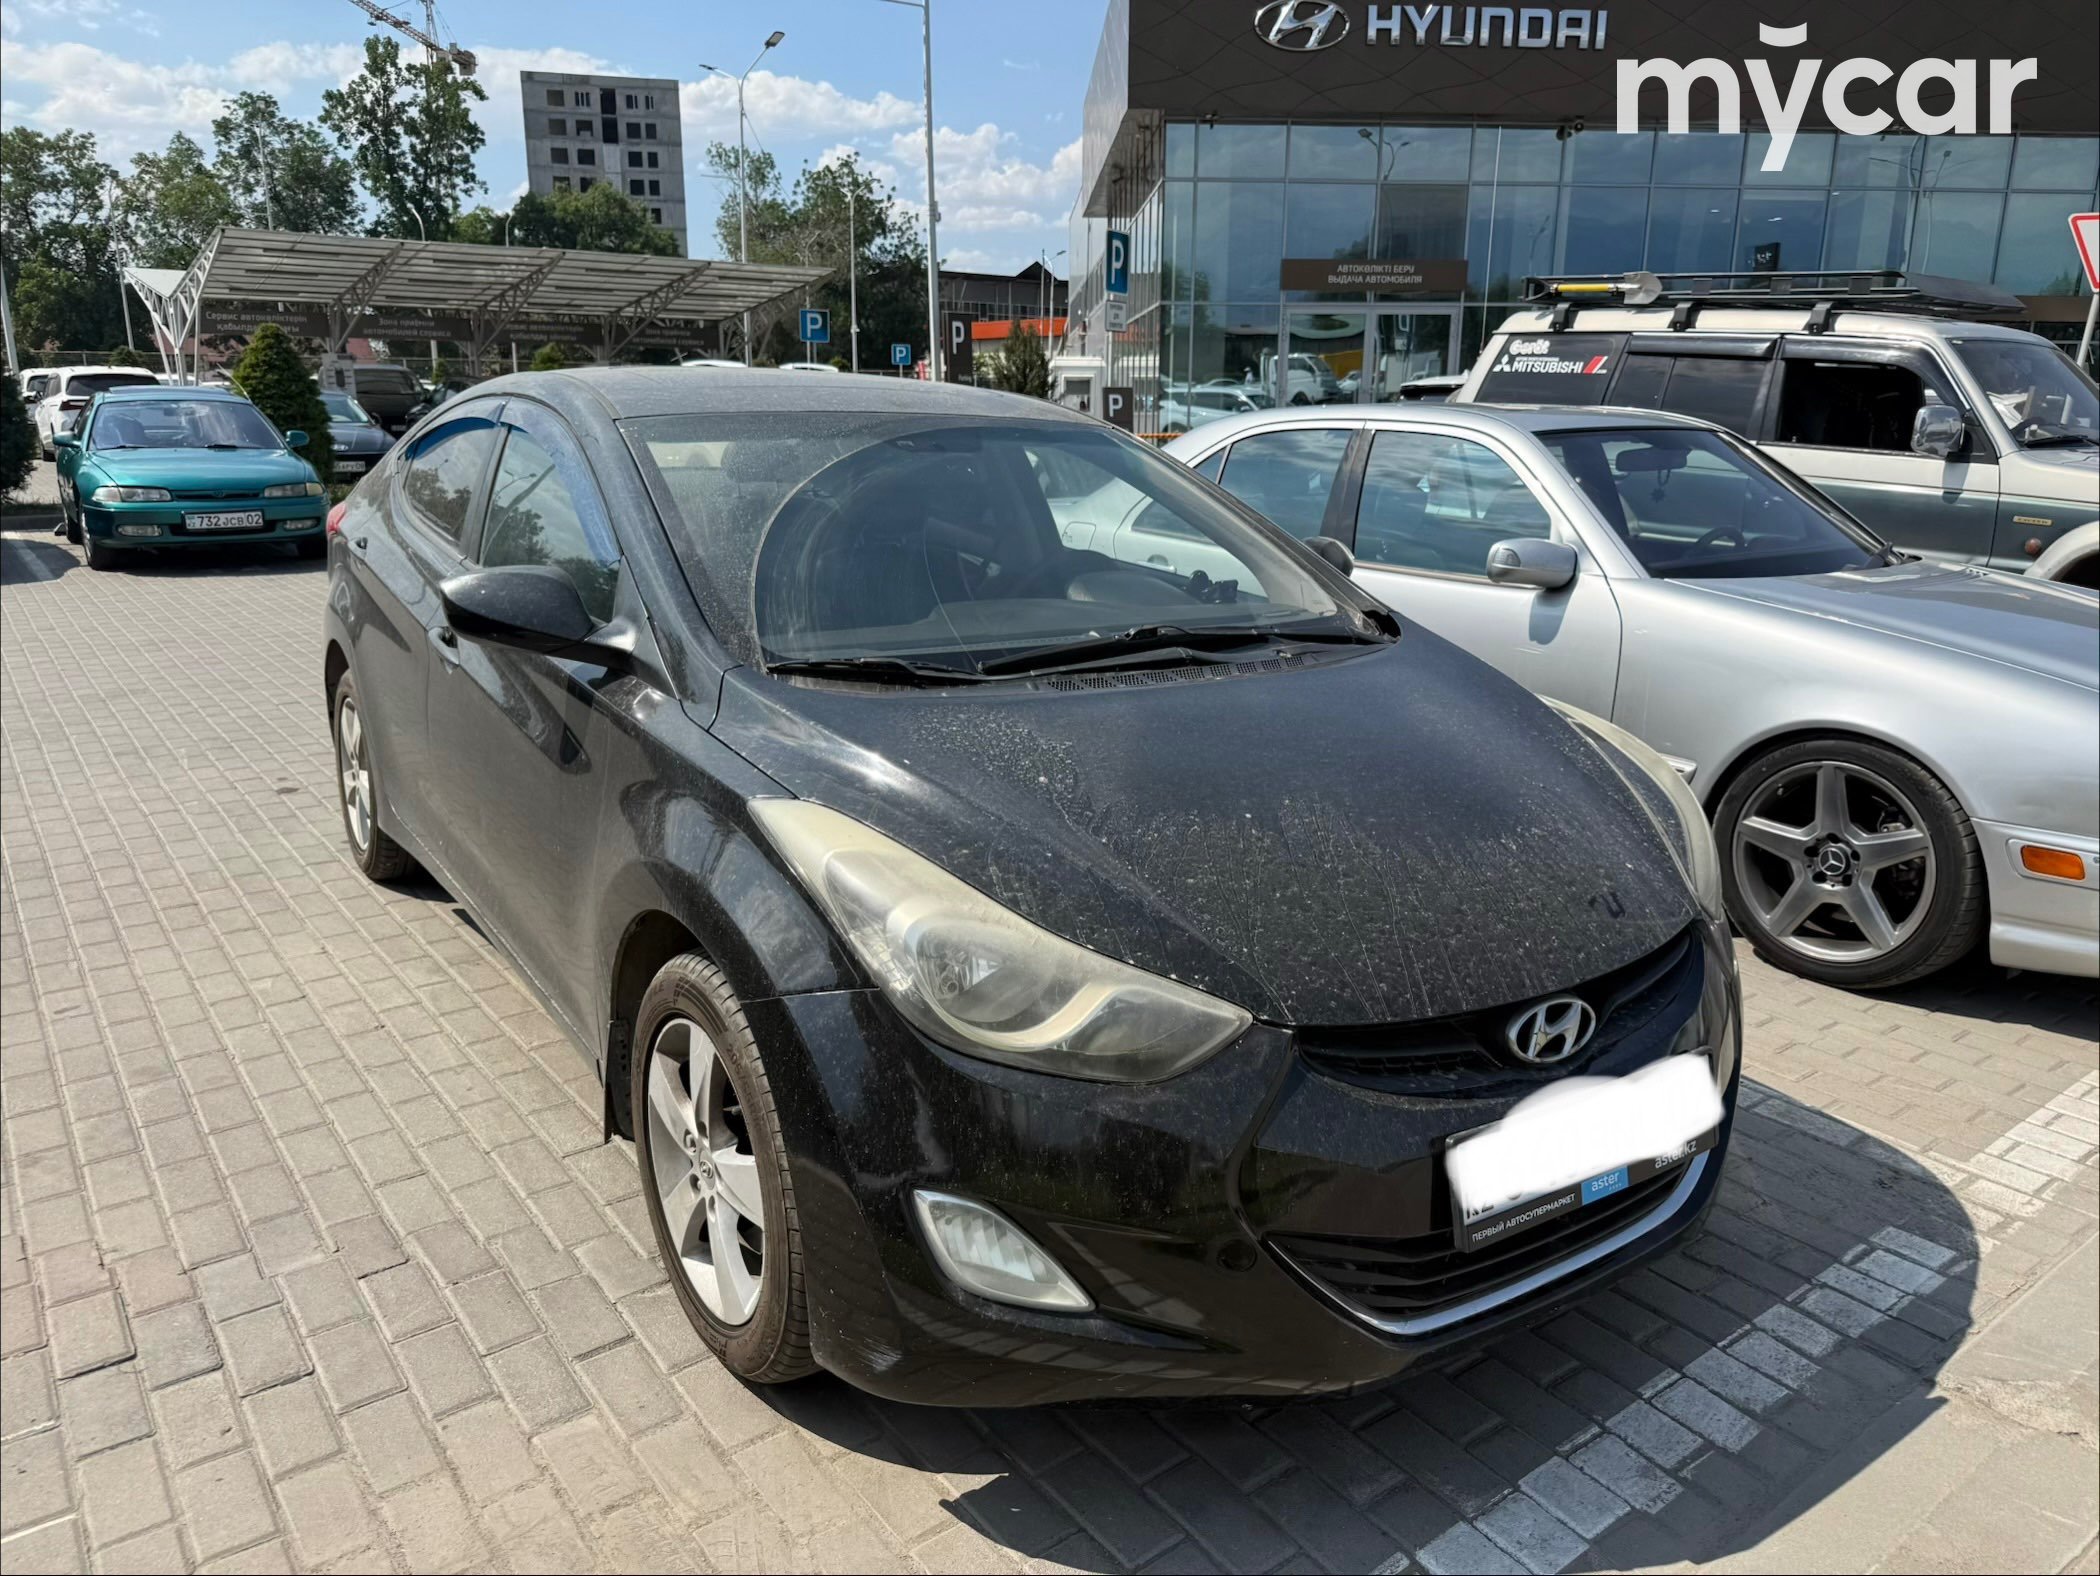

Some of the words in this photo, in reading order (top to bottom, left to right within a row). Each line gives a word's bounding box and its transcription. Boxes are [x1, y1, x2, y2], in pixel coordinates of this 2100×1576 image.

[1366, 4, 1608, 50] HYUNDAI
[1111, 239, 1125, 285] P
[1393, 264, 1415, 274] БЕРУ
[1328, 275, 1364, 285] ВЫДАЧА
[1365, 275, 1423, 285] АВТОМОБИЛЯ
[206, 311, 238, 321] Сервис
[807, 313, 823, 338] P
[952, 321, 965, 354] P
[896, 347, 907, 363] P
[1511, 361, 1584, 373] MITSUBISHI
[1108, 394, 1123, 417] P
[1655, 1140, 1697, 1169] aster.kz
[1591, 1171, 1621, 1192] aster
[1472, 1222, 1505, 1243] ПЕРВЫЙ
[1505, 1193, 1576, 1229] АВТОСУПЕРМАРКЕТ
